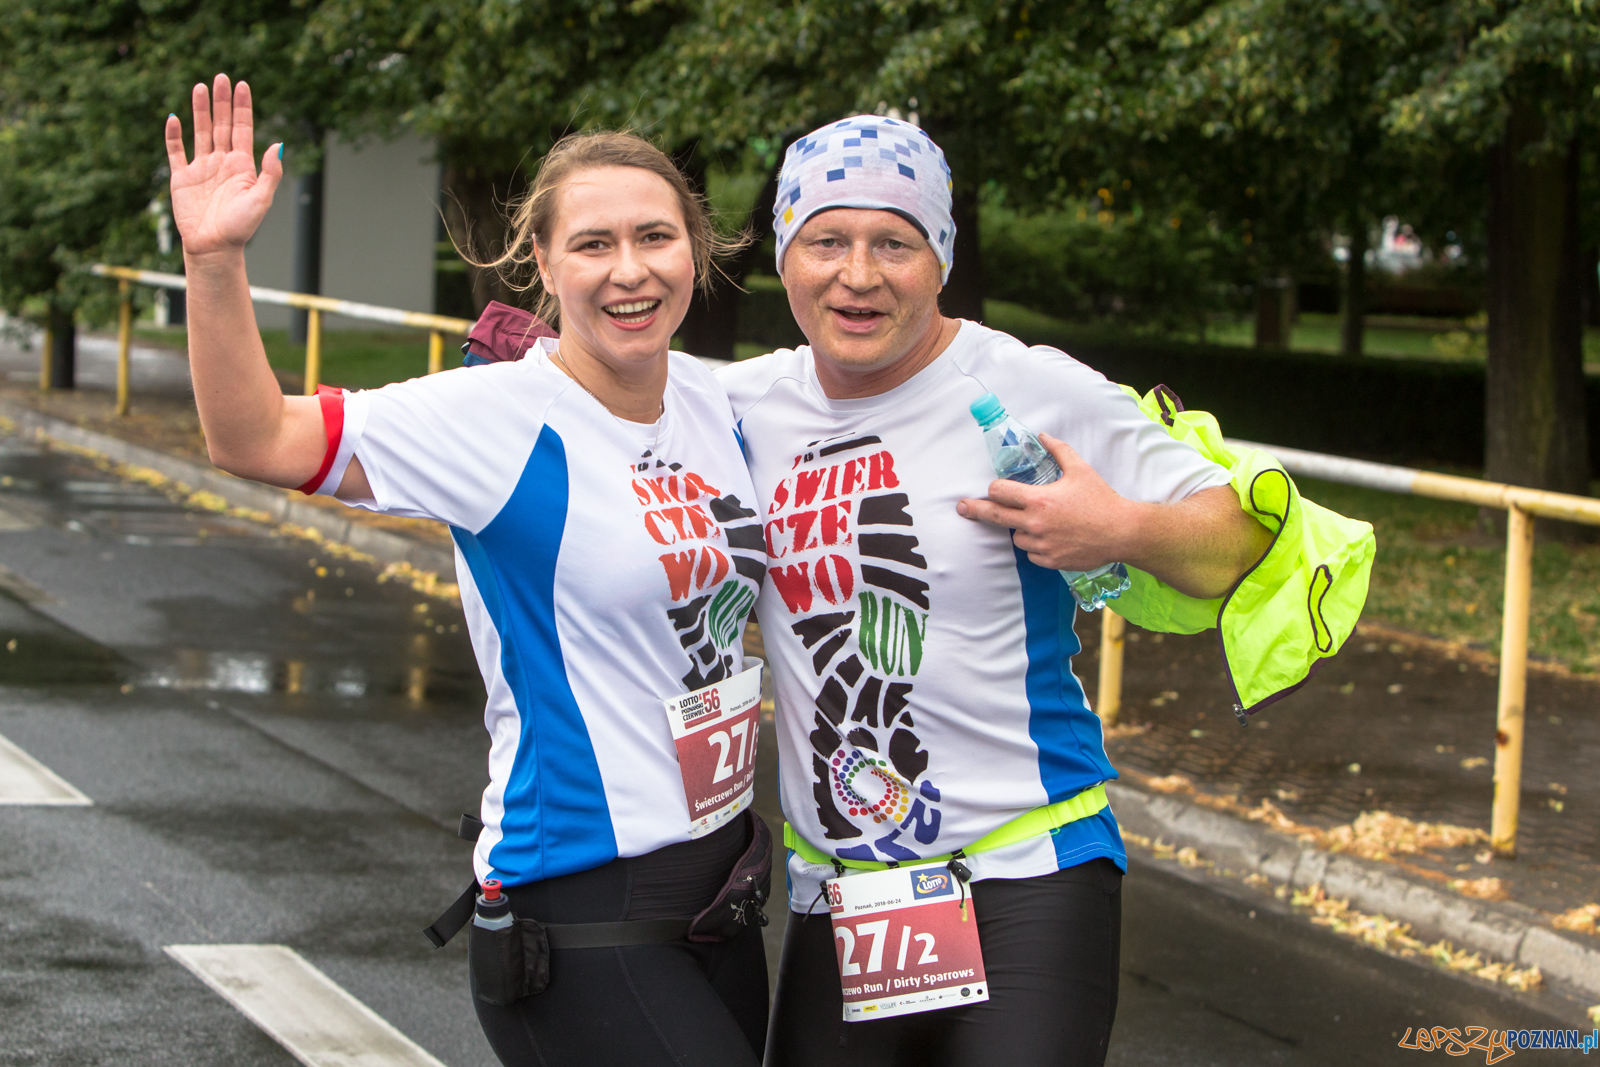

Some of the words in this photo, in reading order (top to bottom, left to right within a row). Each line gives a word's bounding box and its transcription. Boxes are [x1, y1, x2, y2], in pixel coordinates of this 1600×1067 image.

[764, 500, 853, 559] CZE
[658, 545, 730, 602] WO
[768, 554, 855, 615] WO
[858, 590, 929, 677] RUN
[679, 695, 699, 709] LOTTO
[695, 787, 734, 812] Świerczewo
[922, 877, 943, 891] LOTTO
[863, 982, 884, 994] Run
[893, 974, 921, 989] Dirty
[923, 968, 975, 984] Sparrows
